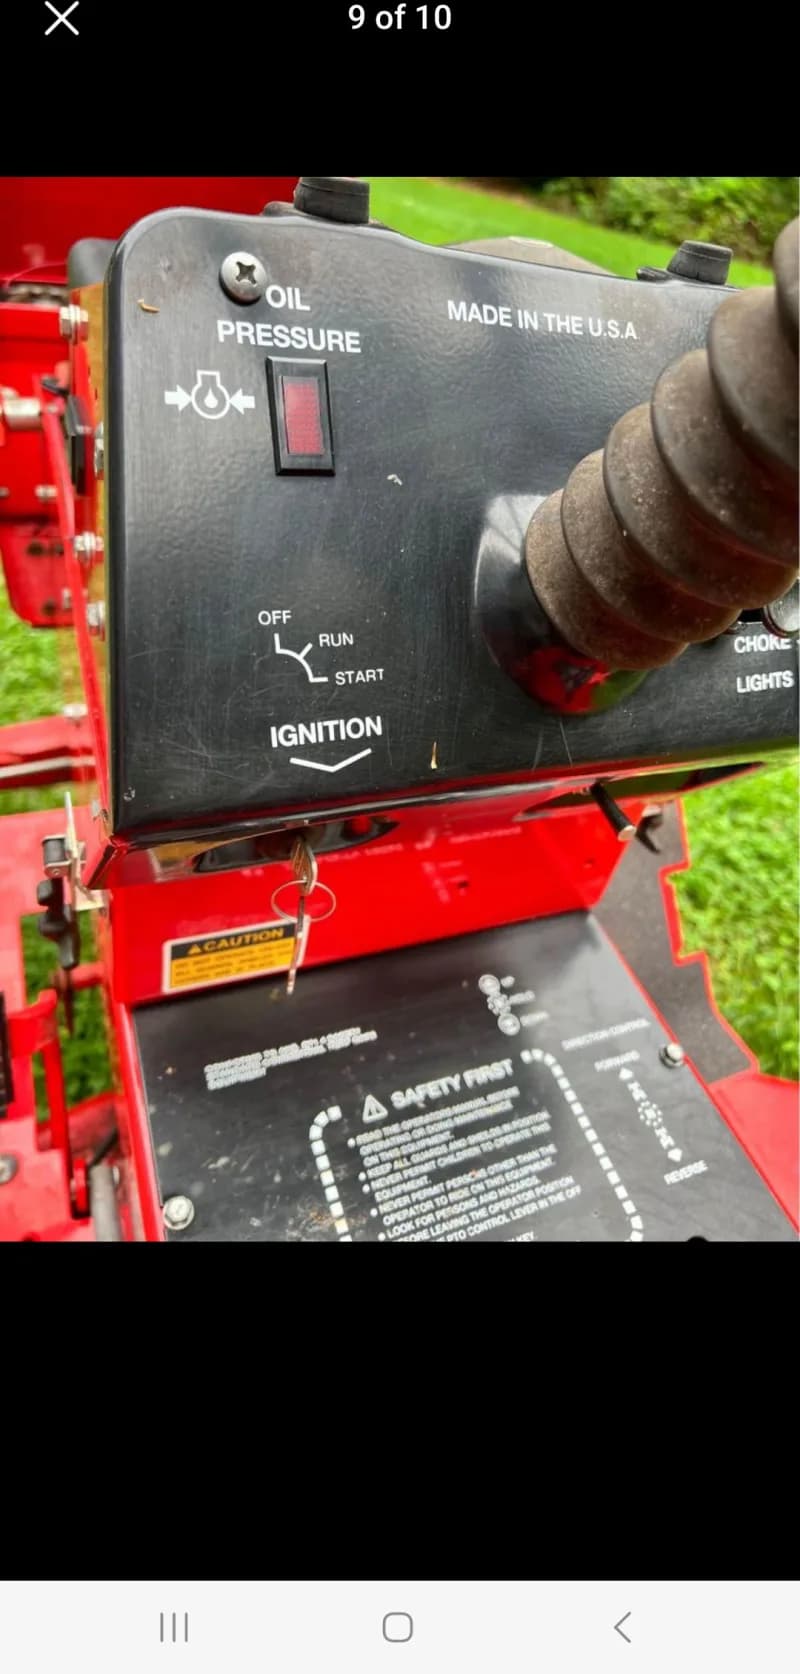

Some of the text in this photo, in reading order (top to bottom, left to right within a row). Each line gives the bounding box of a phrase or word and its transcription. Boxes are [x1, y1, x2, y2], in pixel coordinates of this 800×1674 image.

[265, 285, 311, 311] OIL
[447, 300, 513, 328] MADE
[517, 308, 539, 331] IN
[543, 313, 584, 336] THE
[217, 319, 362, 353] PRESSURE
[257, 610, 292, 626] OFF
[318, 632, 355, 648] RUN
[734, 633, 792, 653] CHOKE
[335, 668, 385, 686] START
[736, 669, 795, 694] LIGHTS
[270, 715, 383, 748] IGNITION
[203, 927, 285, 953] CAUTION
[390, 1058, 514, 1110] SAFETY FIRST
[363, 1155, 379, 1167] ON
[367, 1162, 392, 1179] KEEP
[394, 1157, 411, 1170] ALL
[371, 1172, 403, 1191] NEVER
[402, 1160, 437, 1179] PERMIT
[481, 1141, 495, 1153] TO
[663, 1159, 709, 1185] REVERSE
[375, 1175, 432, 1202] EQUIPMENT.
[379, 1195, 411, 1214] NEVER
[411, 1182, 446, 1202] PERMIT
[487, 1157, 517, 1176] OTHER
[516, 1150, 541, 1165] THAN
[383, 1200, 434, 1226] OPERATOR
[434, 1195, 448, 1207] TO
[448, 1186, 471, 1203] RIDE
[470, 1182, 486, 1195] ON
[484, 1174, 506, 1190] THIS
[430, 1214, 470, 1237] LEAVING
[469, 1207, 489, 1222] THE
[488, 1190, 536, 1215] OPERATOR
[467, 1214, 511, 1237] CONTROL
[510, 1202, 539, 1221] LEVER
[538, 1198, 549, 1210] IN
[548, 1192, 566, 1206] THE
[566, 1184, 581, 1199] OFF
[387, 1220, 415, 1239] LOOK
[415, 1213, 436, 1229] FOR
[435, 1198, 479, 1221] PERSONS
[479, 1190, 498, 1206] AND
